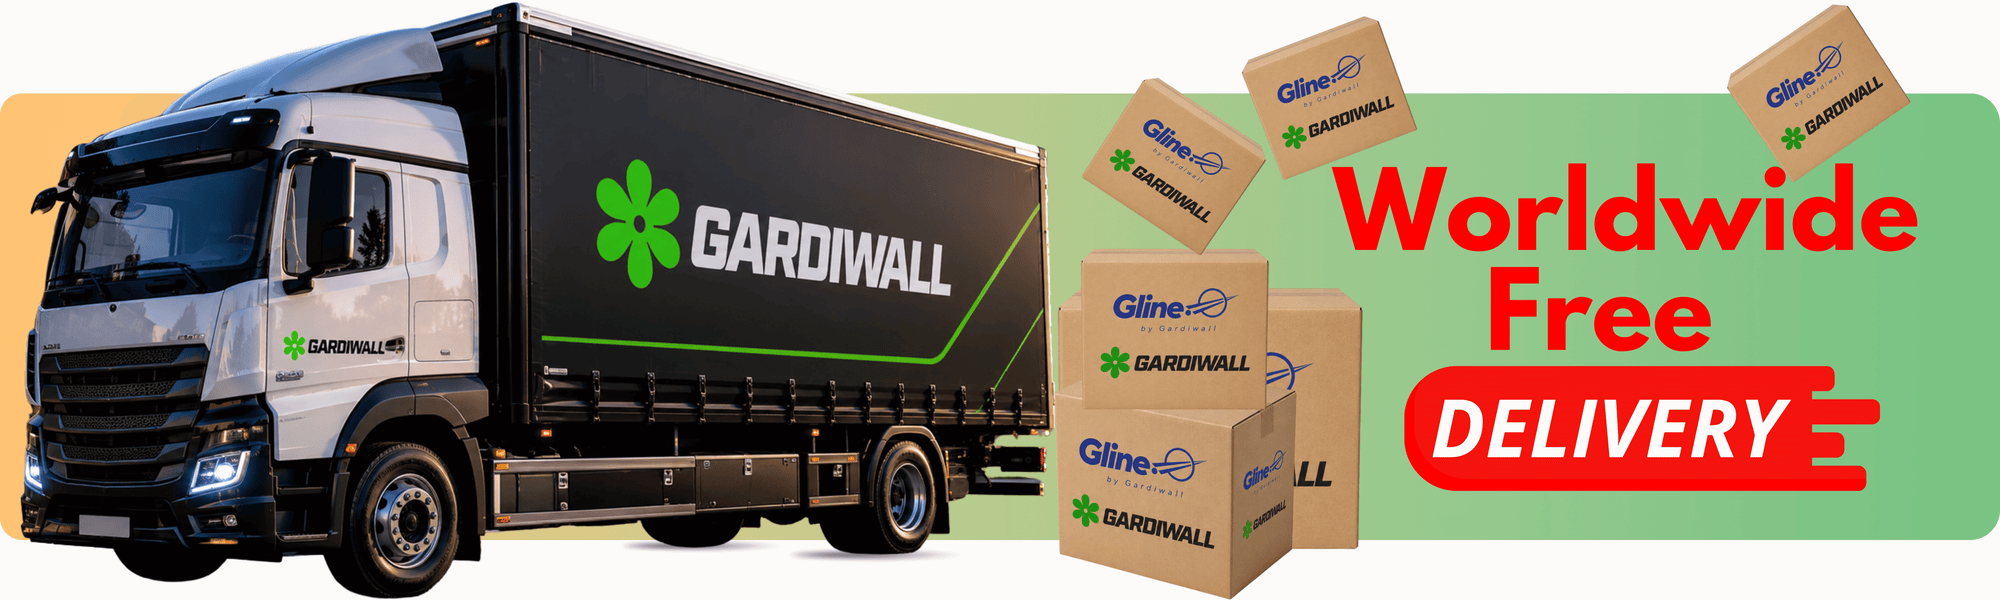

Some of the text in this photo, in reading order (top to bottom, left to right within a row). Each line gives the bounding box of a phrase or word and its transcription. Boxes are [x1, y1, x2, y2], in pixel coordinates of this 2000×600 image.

[1317, 82, 1359, 102] Gardiwall
[1804, 76, 1884, 136] GARDIWALL
[1309, 96, 1395, 138] GARDIWALL
[1132, 166, 1211, 223] GARDIWALL
[690, 204, 952, 297] GARDIWALL
[1140, 325, 1153, 333] by
[307, 338, 385, 355] GARDIWALL
[1134, 355, 1250, 372] GARDIWALL
[1106, 476, 1184, 498] by Gardiwall
[1103, 507, 1215, 550] GARDIWALL
[1253, 499, 1287, 531] GARDIWALL
